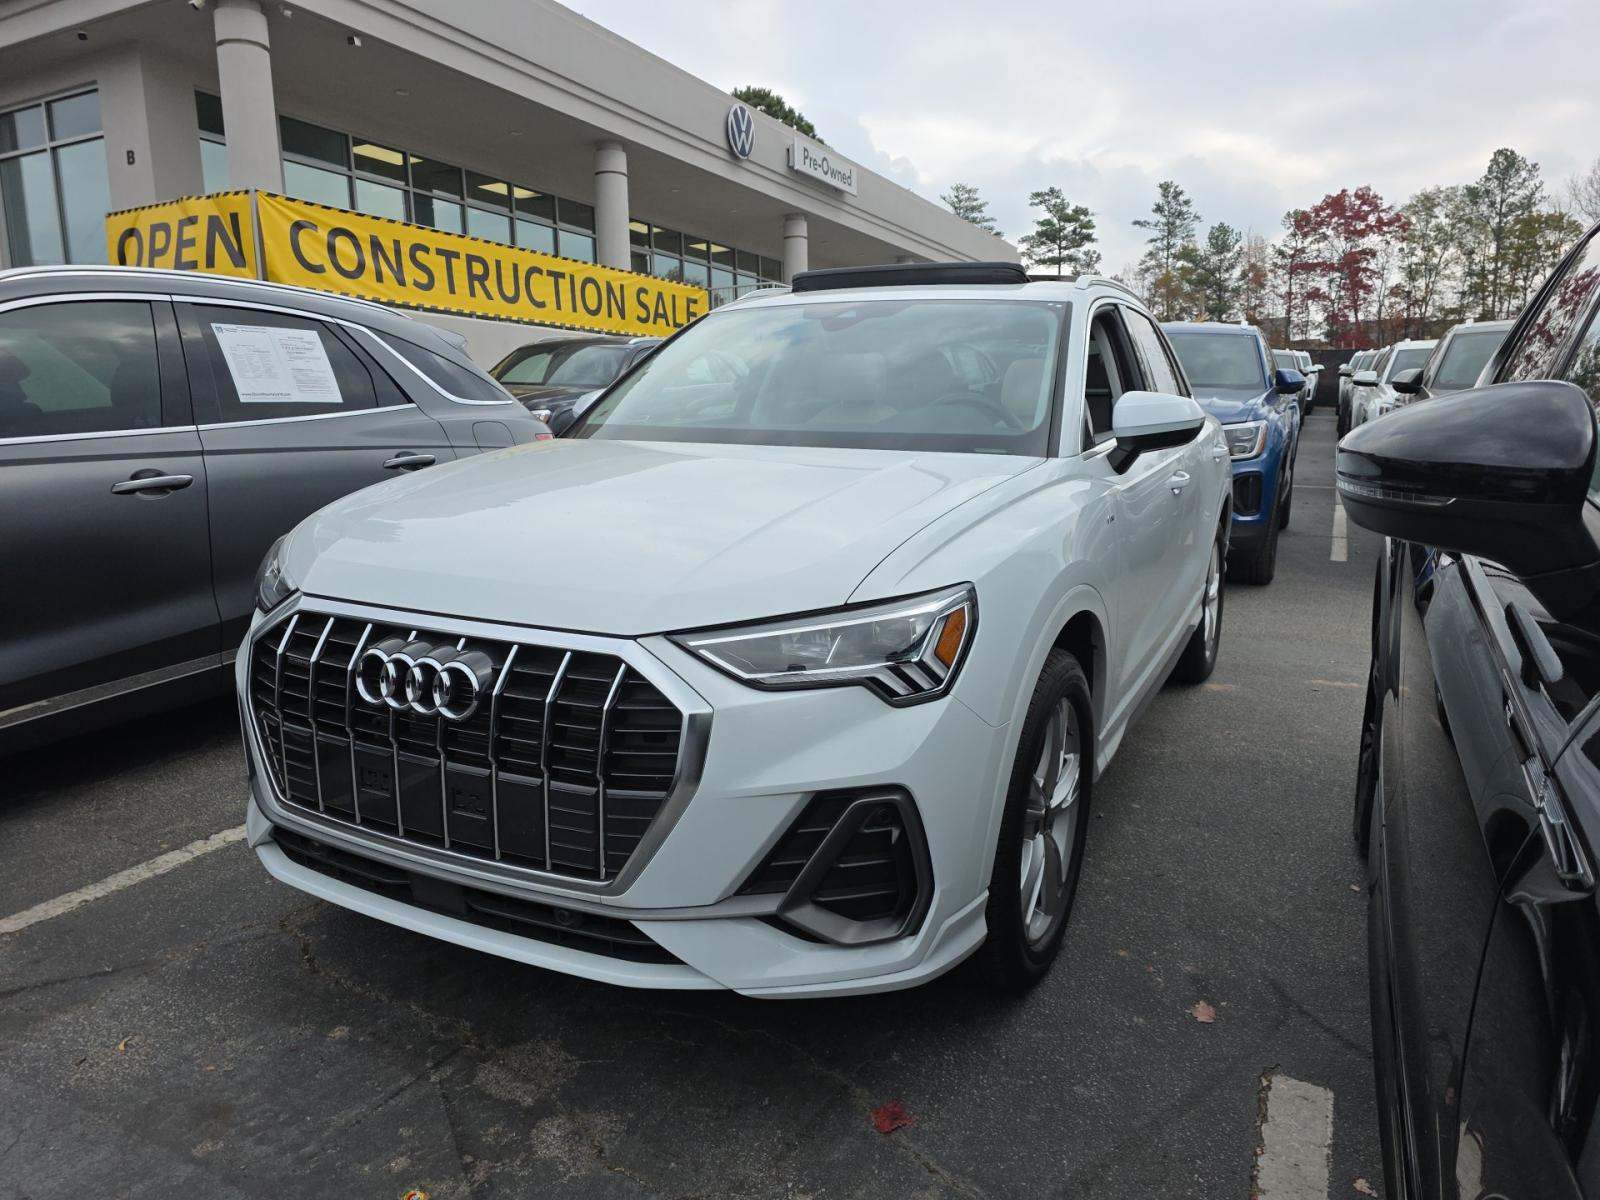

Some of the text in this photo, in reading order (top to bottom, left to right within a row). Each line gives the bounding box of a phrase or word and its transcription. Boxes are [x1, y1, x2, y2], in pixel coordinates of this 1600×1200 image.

[126, 149, 136, 166] B
[803, 146, 852, 186] Pre-Owned
[117, 212, 699, 328] OPEN CONSTRUCTION SALE
